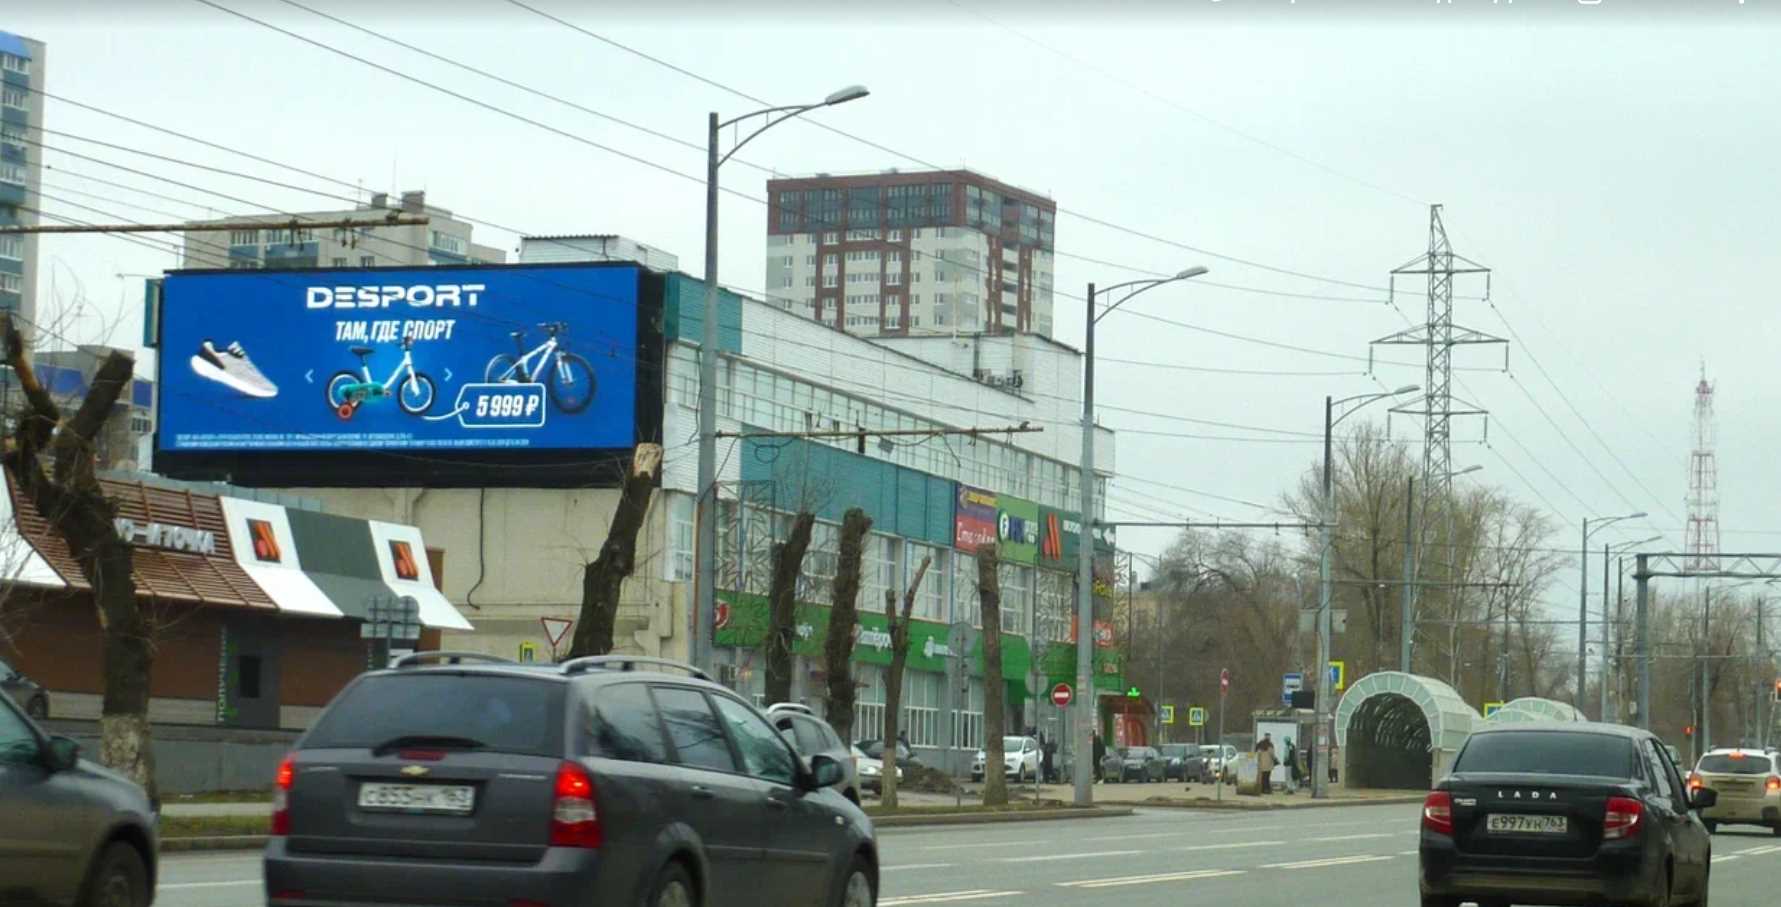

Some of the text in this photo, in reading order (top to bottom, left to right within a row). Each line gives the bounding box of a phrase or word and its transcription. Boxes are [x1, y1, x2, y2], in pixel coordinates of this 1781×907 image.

[306, 284, 486, 308] DESPORT
[370, 319, 401, 343] ГДЕ
[402, 319, 456, 340] СПОРТ
[1497, 790, 1557, 799] LADA
